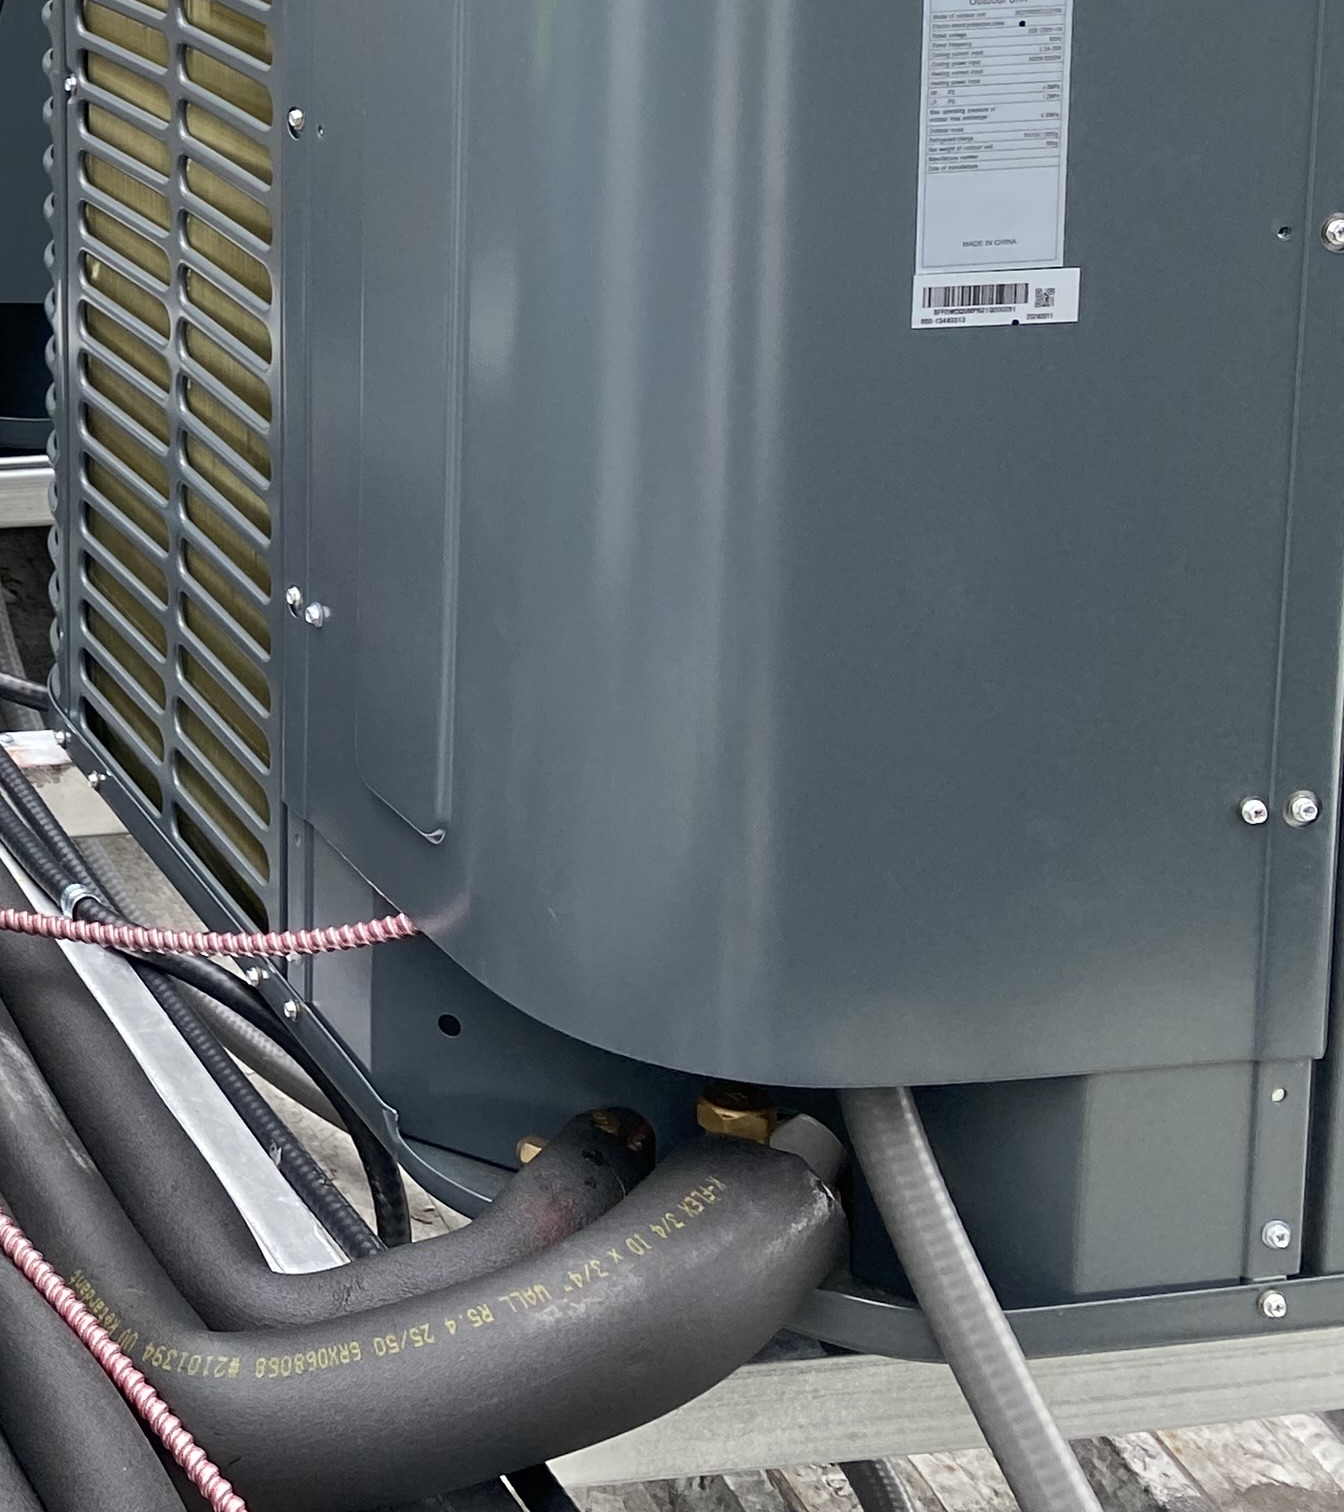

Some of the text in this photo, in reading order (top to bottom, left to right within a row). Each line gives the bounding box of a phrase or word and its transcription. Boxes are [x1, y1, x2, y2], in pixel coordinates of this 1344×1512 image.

[649, 1212, 686, 1239] 3/4
[498, 1283, 552, 1312] WALL
[443, 1303, 495, 1335] R5.4
[373, 1322, 435, 1356] 25/50
